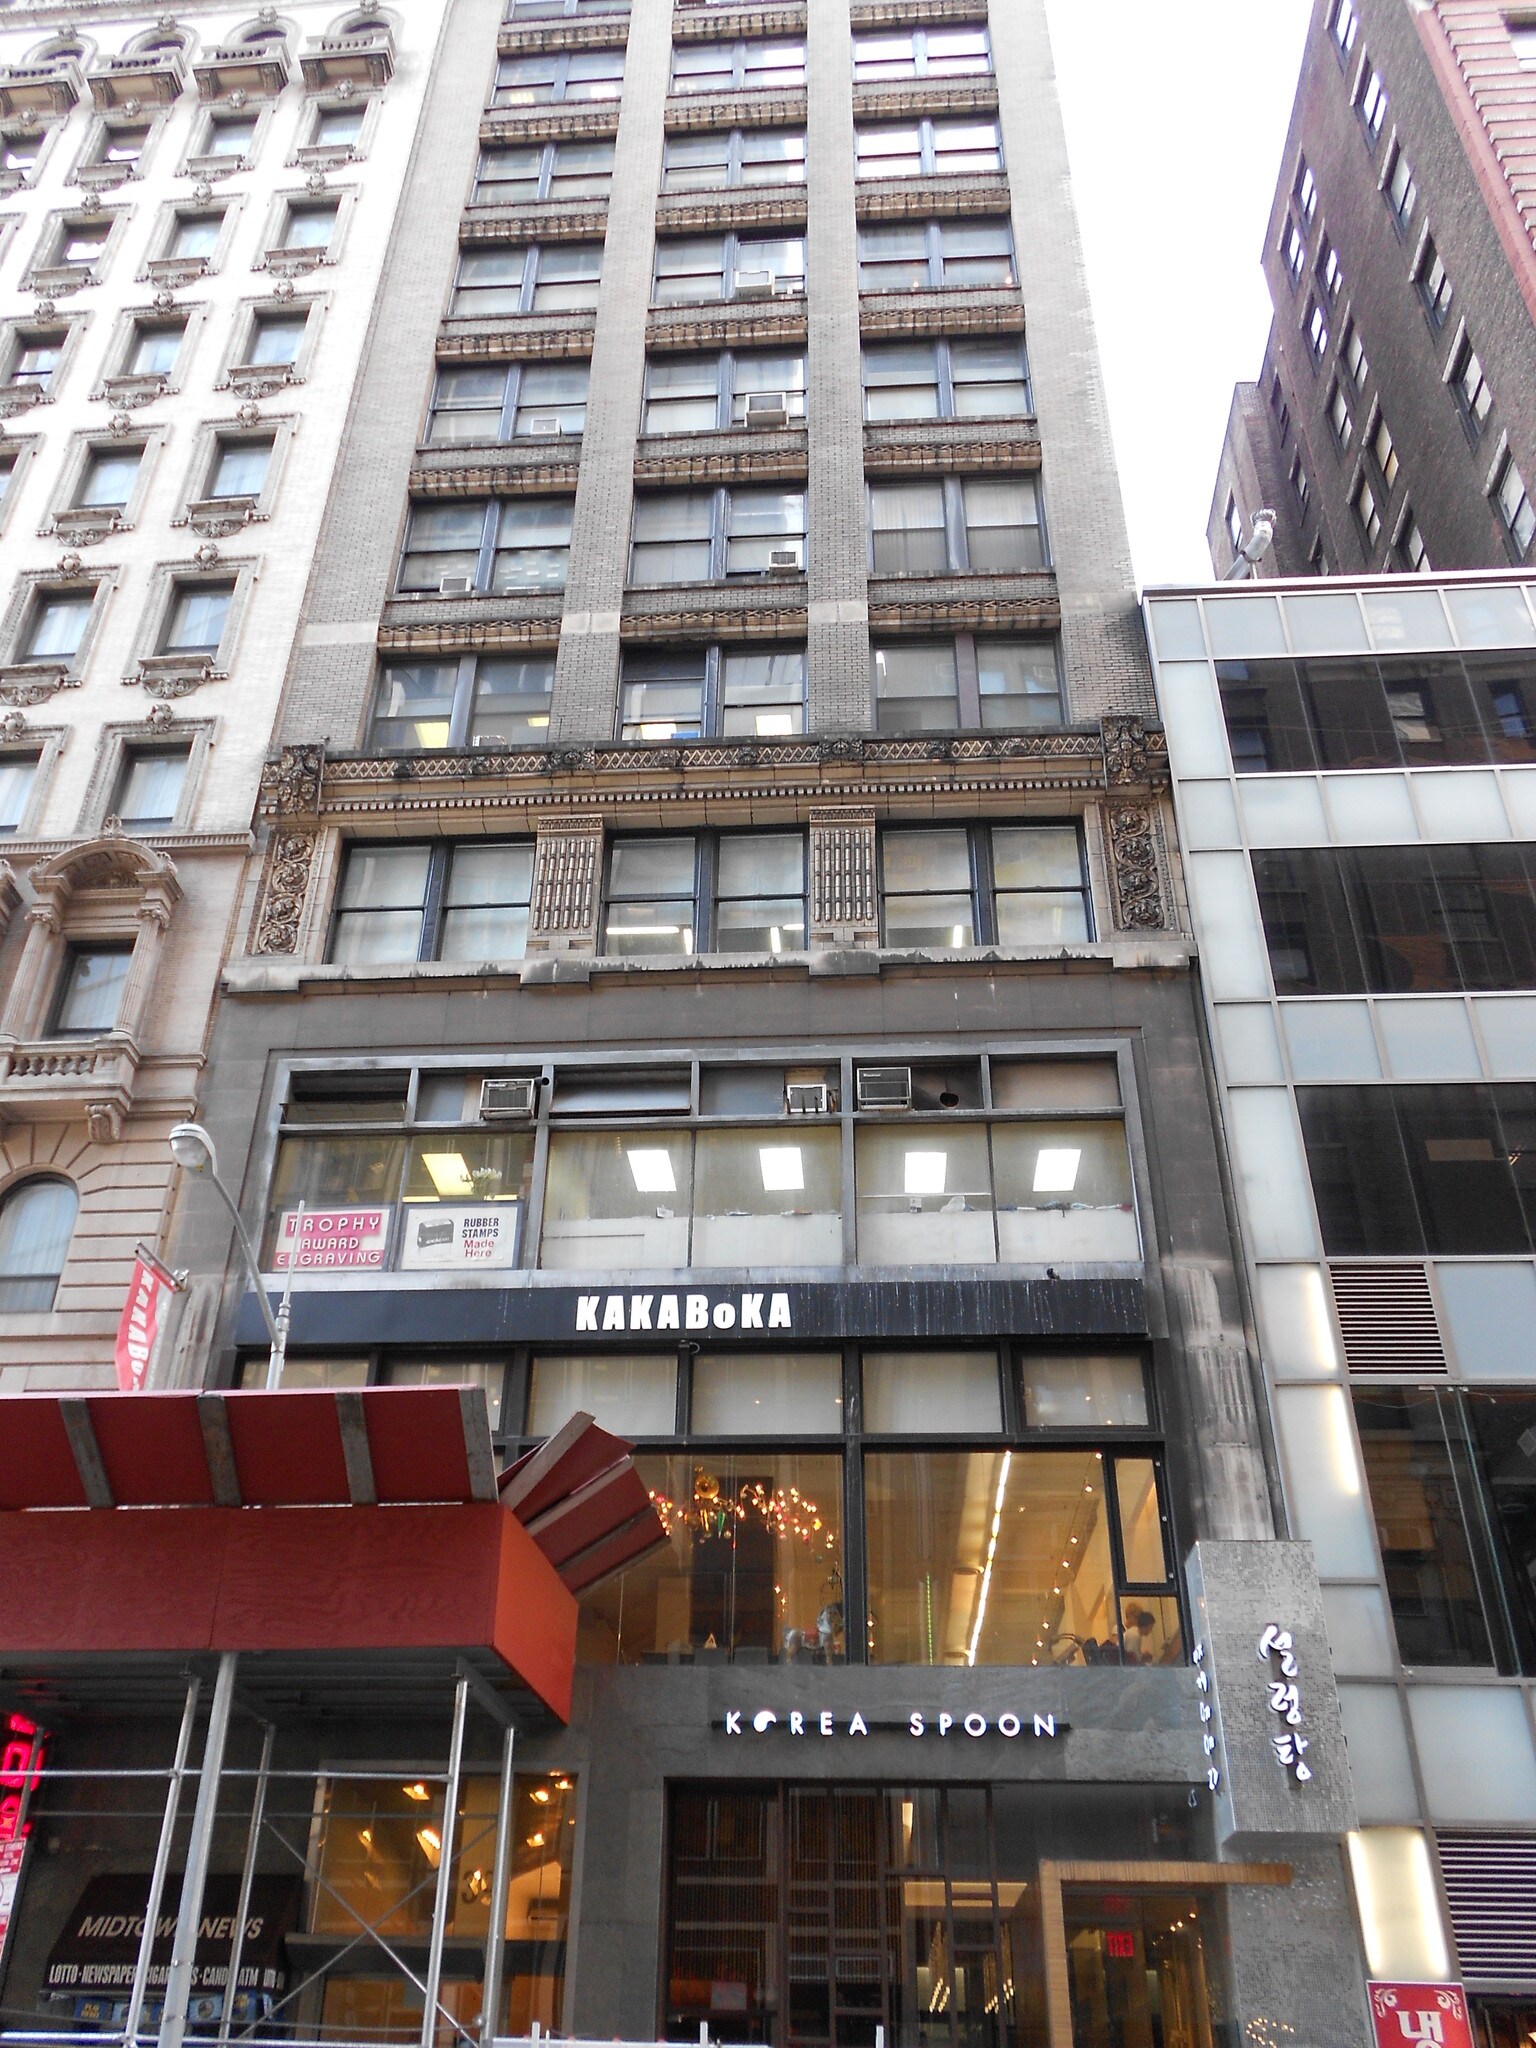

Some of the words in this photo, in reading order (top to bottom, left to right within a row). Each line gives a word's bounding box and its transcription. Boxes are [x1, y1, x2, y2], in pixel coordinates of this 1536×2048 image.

[289, 1217, 379, 1232] TROPHY
[463, 1217, 499, 1228] RUBBER
[462, 1228, 499, 1239] STAMPS
[301, 1237, 359, 1250] AWARD
[463, 1239, 495, 1248] Made
[464, 1249, 492, 1258] Here
[725, 1710, 868, 1736] KOREA
[909, 1712, 1056, 1738] SPOON
[48, 1964, 79, 1984] LOTTO
[237, 1967, 259, 1987] ATM
